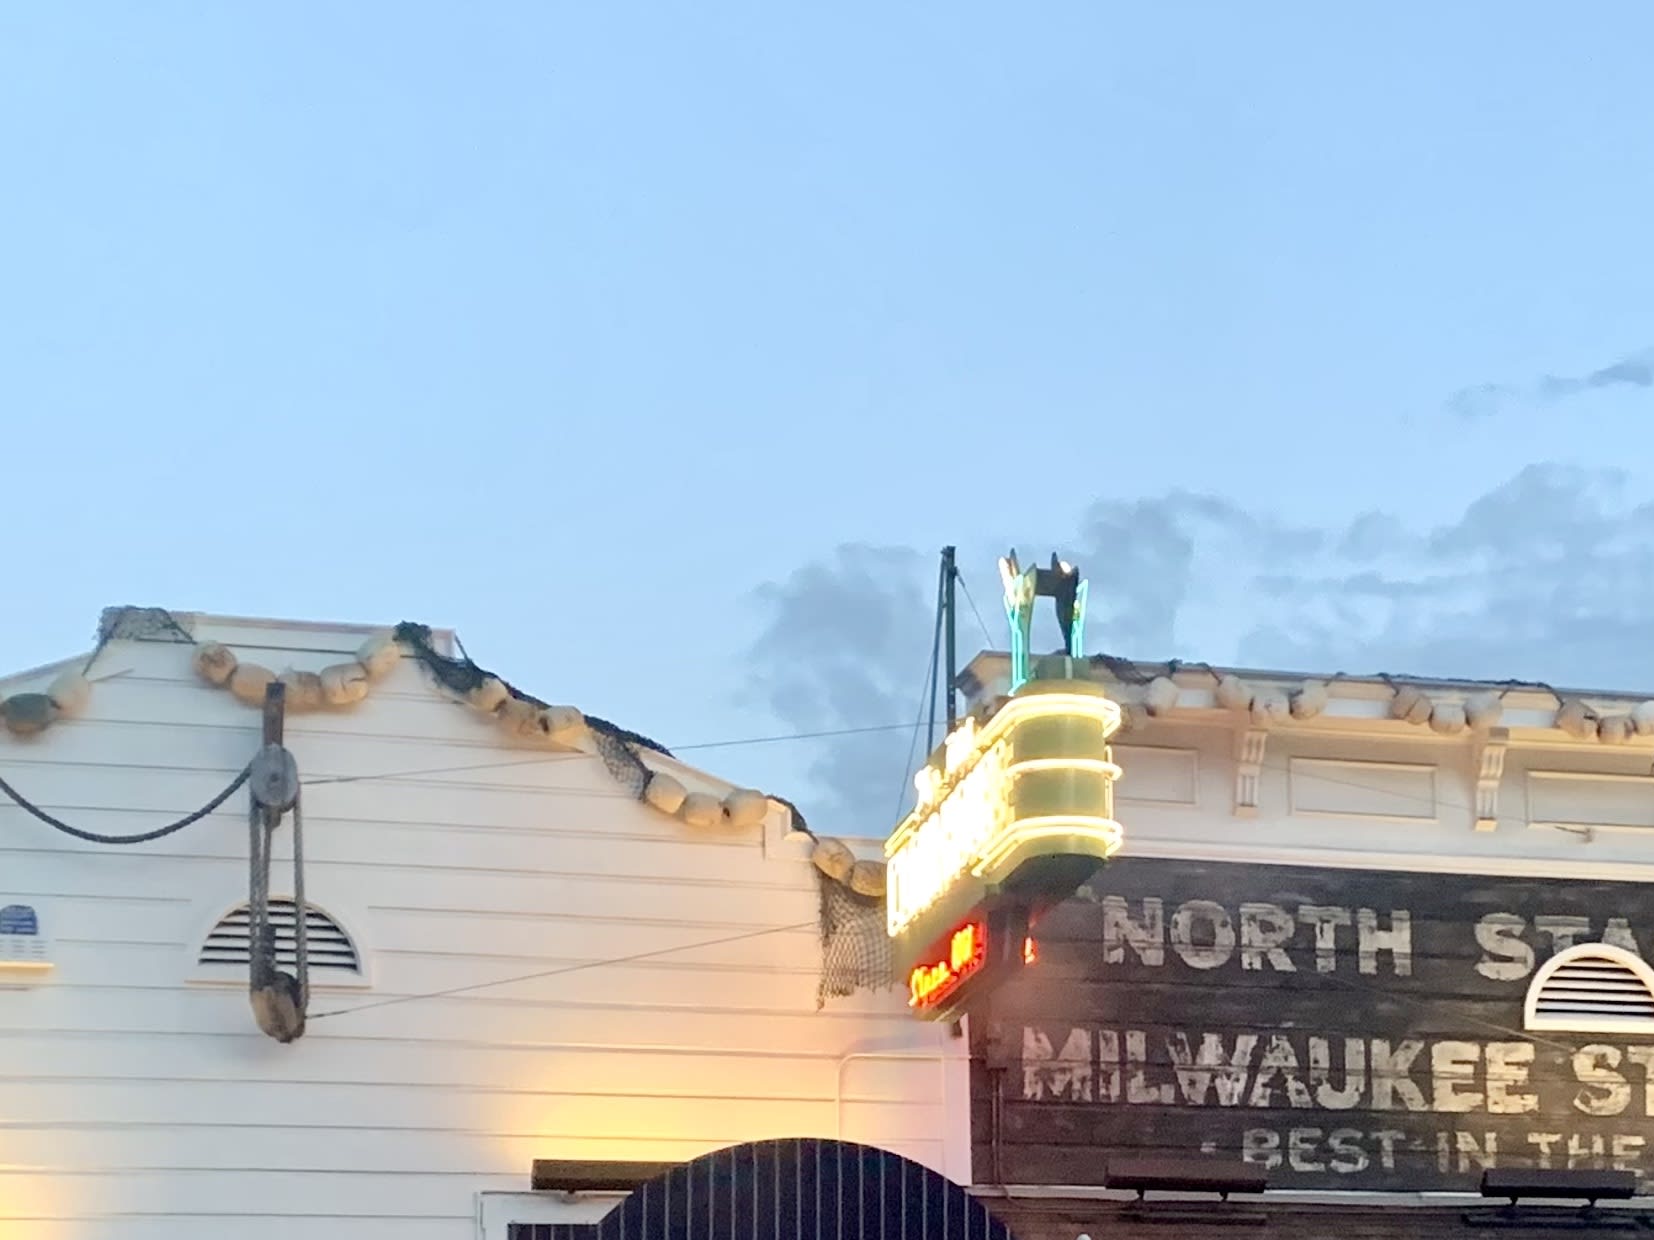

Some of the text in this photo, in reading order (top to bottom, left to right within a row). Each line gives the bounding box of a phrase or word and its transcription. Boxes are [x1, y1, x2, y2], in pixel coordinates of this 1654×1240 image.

[1100, 896, 1414, 977] NORTH
[1022, 1027, 1540, 1114] MILWAUKEE
[1242, 1127, 1406, 1174] BEST
[1436, 1130, 1498, 1174] IN
[1527, 1132, 1646, 1178] THE
